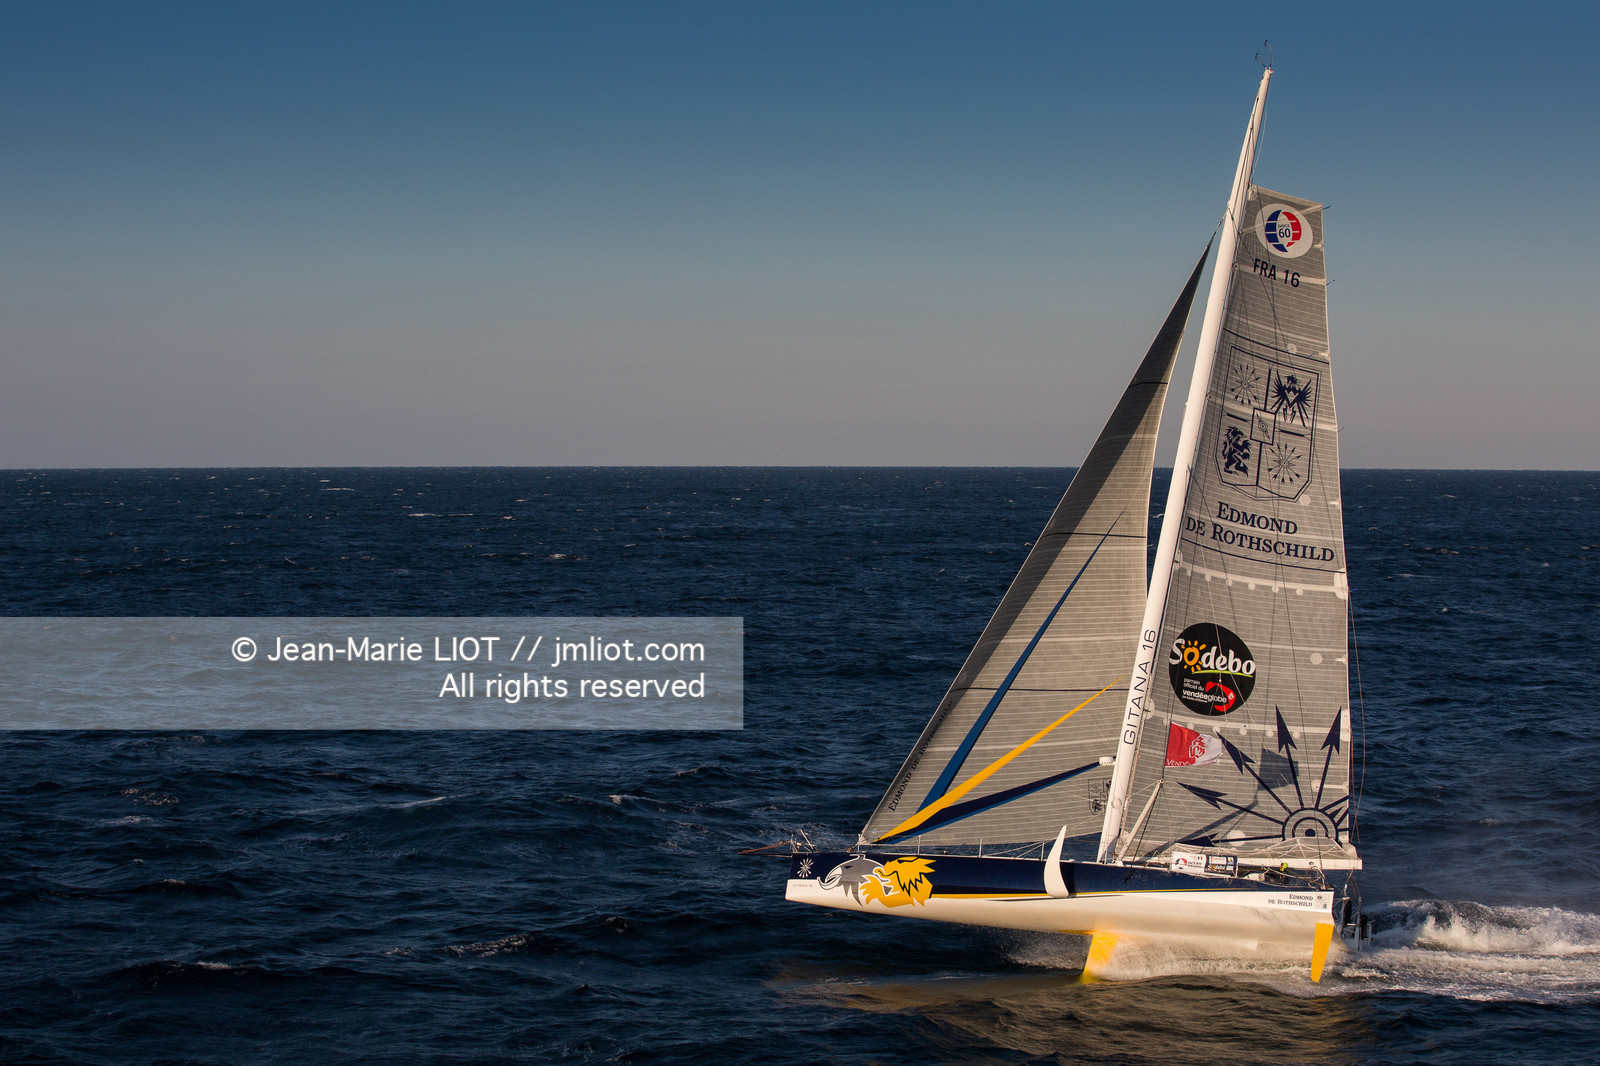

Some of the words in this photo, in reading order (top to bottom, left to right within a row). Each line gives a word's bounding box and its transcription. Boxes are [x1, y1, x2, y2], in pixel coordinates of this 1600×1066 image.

[1278, 228, 1291, 238] 60
[1253, 257, 1277, 281] FRA
[1284, 269, 1301, 288] 16
[1216, 501, 1298, 535] EDMOND
[1185, 516, 1206, 536] DE
[1211, 523, 1335, 562] ROTHSCHILD
[1169, 638, 1256, 675] Sodebo
[1123, 661, 1150, 745] GITANA
[1142, 629, 1156, 651] 16
[888, 772, 912, 812] EDMOND
[1277, 899, 1313, 907] ROTHSCHILD
